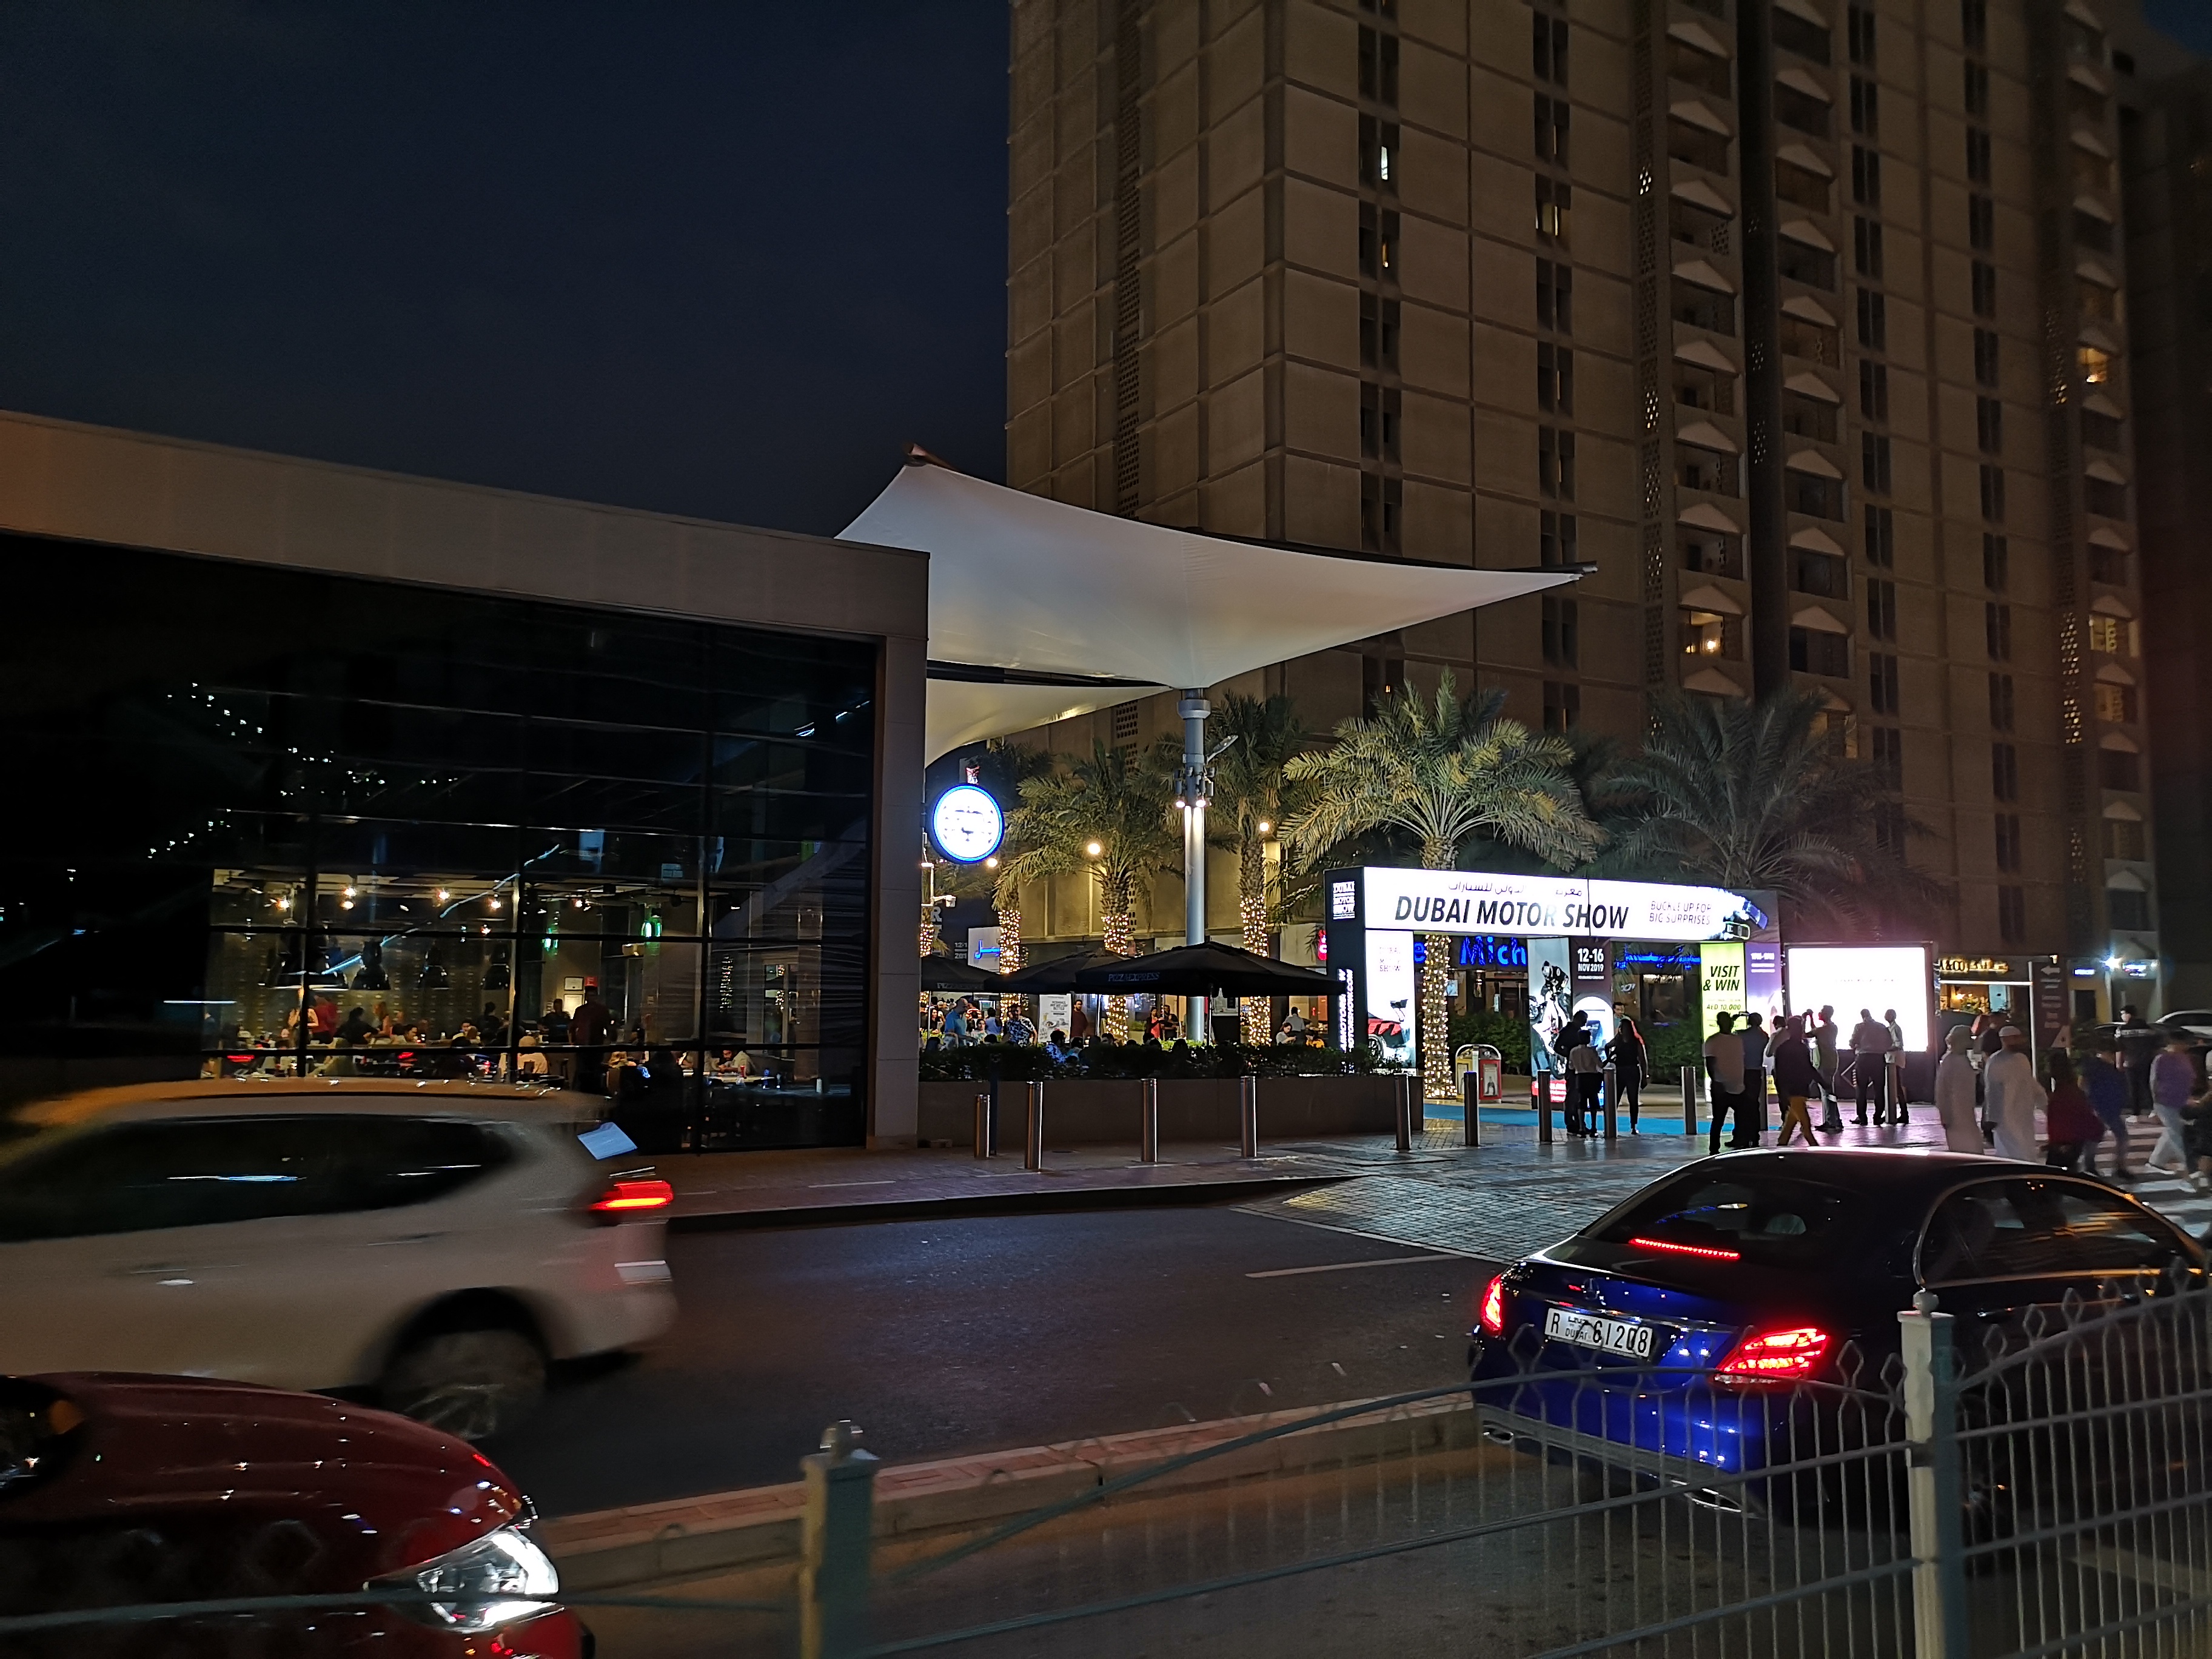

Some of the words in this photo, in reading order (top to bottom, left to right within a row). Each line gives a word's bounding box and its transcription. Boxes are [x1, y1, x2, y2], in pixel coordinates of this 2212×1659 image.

[1395, 896, 1470, 923] DUBAI
[1476, 900, 1557, 927] MOTOR
[1563, 903, 1629, 929] SHOW
[1684, 902, 1694, 912] UP
[1649, 913, 1663, 923] BIG
[1666, 914, 1710, 925] SURPRISES
[1577, 948, 1604, 962] 12-16
[1578, 963, 1590, 972] NOV
[1591, 964, 1604, 972] 2019
[1710, 965, 1740, 977] VISIT
[1703, 979, 1712, 991] &
[1715, 979, 1740, 991] WIN
[1550, 1313, 1560, 1334] R
[1592, 1320, 1648, 1353] 61208
